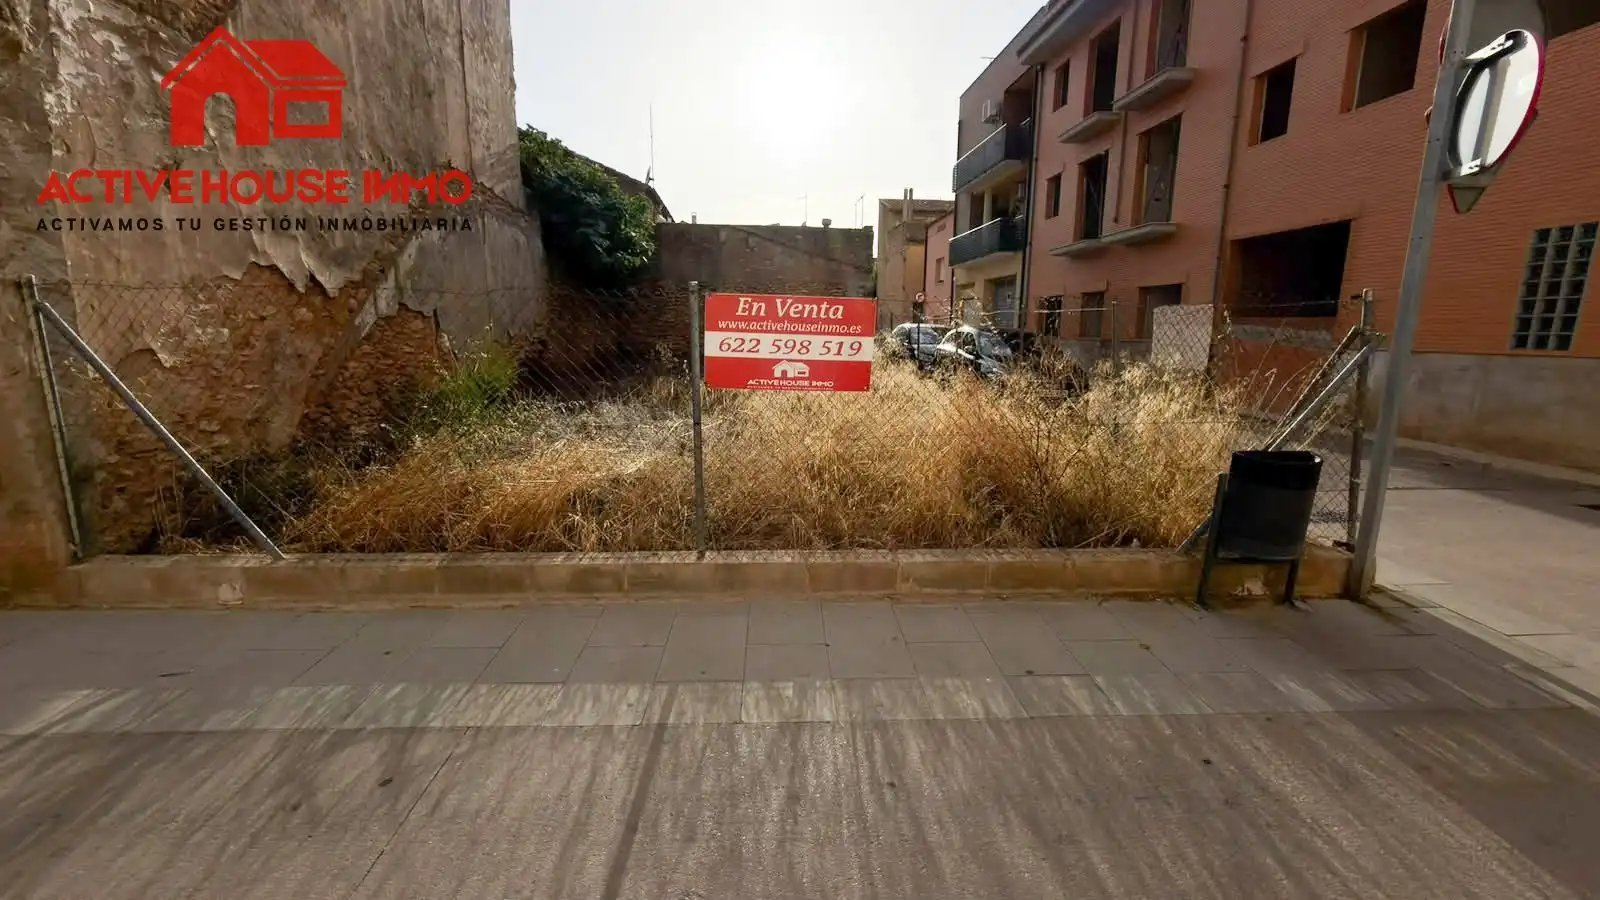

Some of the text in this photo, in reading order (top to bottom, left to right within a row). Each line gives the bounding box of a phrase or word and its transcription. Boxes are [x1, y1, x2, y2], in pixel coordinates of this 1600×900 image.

[736, 297, 844, 320] En Venta
[718, 318, 862, 334] www.activehouseinmo.es
[719, 337, 863, 357] 622 598 519
